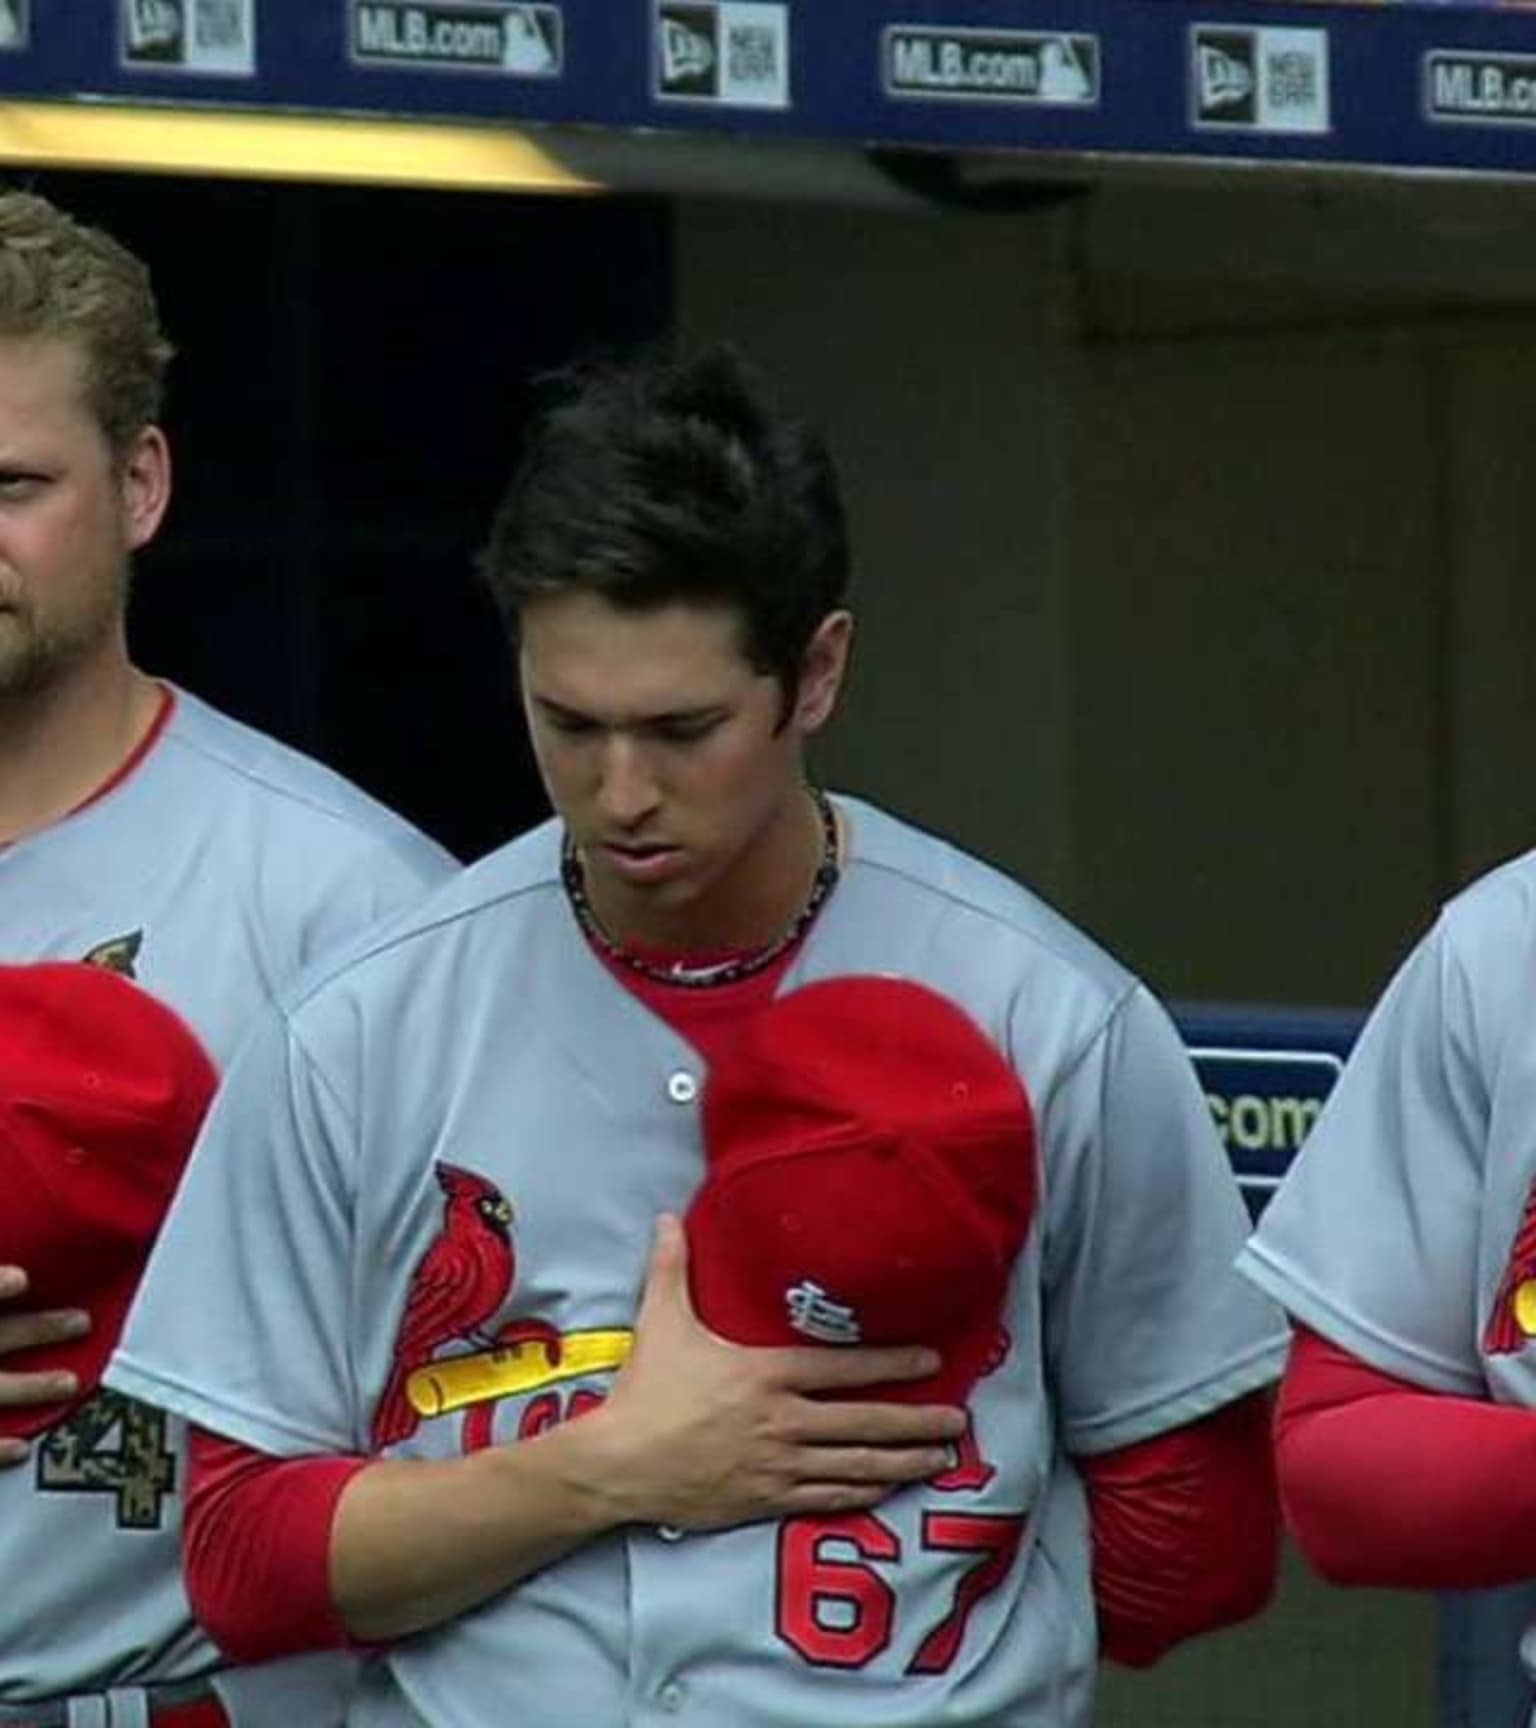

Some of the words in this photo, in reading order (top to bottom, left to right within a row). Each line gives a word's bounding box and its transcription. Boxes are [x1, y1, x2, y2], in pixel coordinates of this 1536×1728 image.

[358, 6, 500, 59] MLB.com
[892, 37, 1038, 90] MLB.com
[35, 1387, 177, 1531] 4
[772, 1508, 1028, 1678] 67
